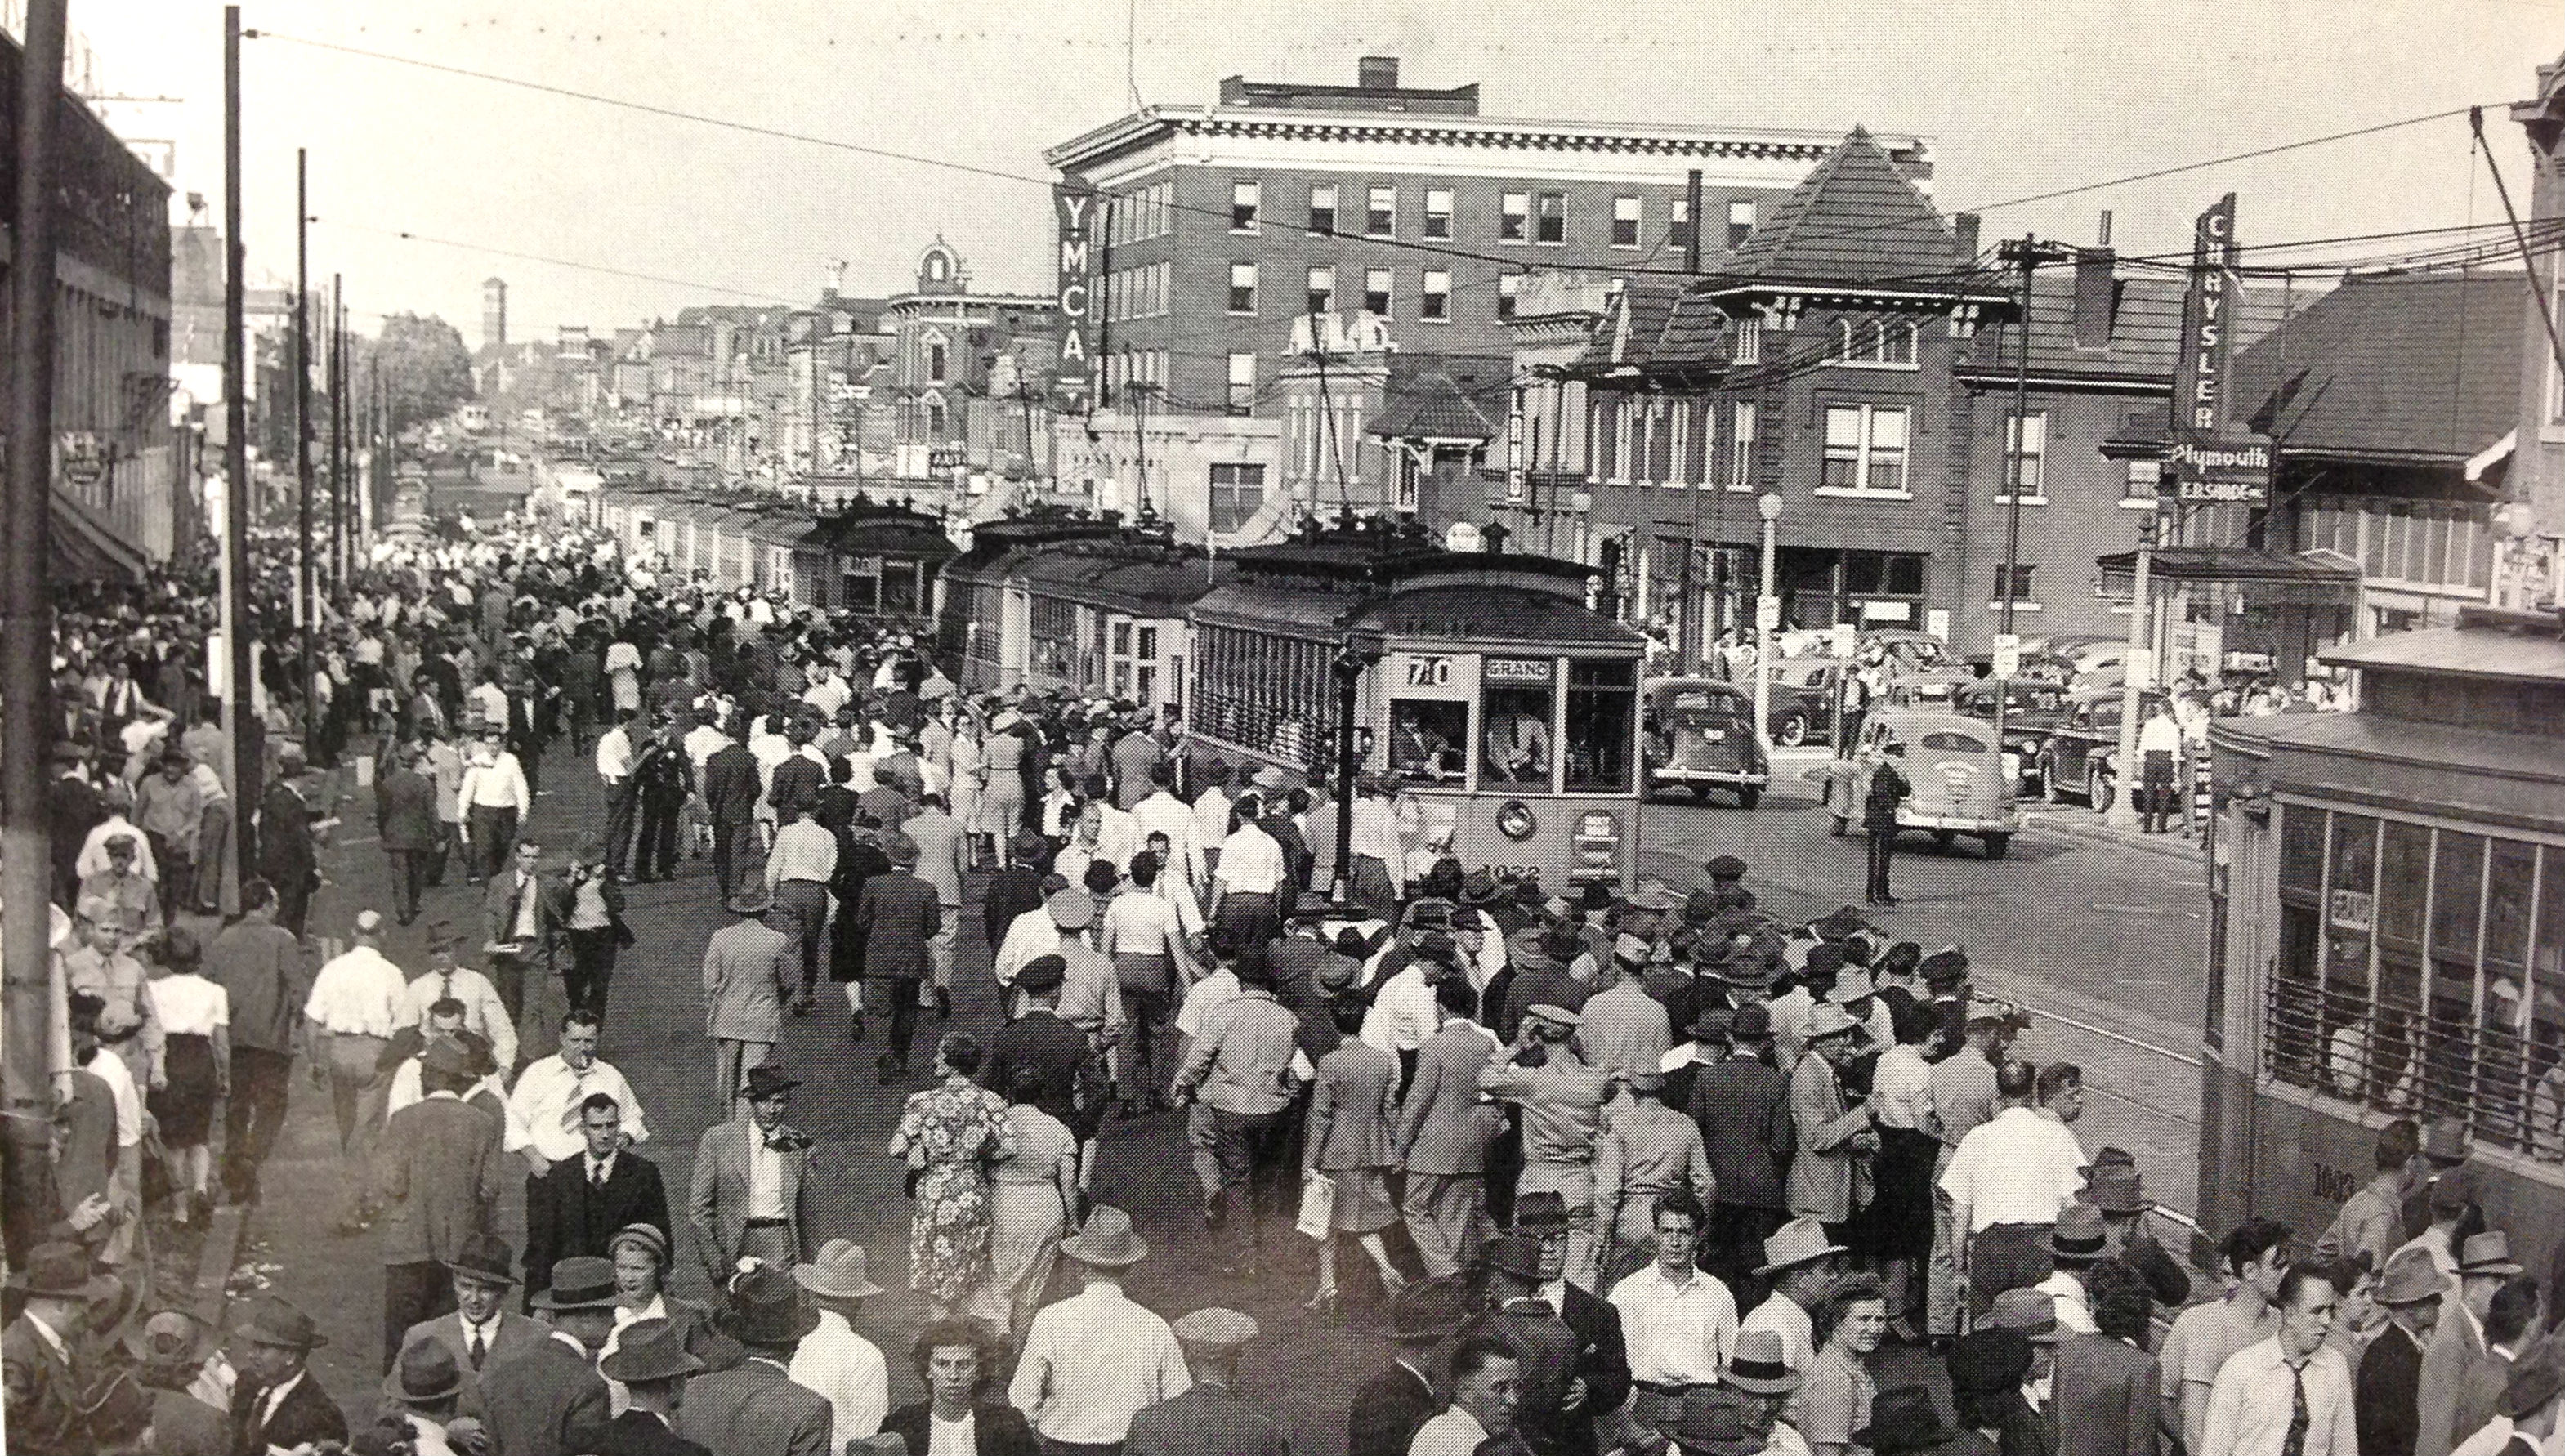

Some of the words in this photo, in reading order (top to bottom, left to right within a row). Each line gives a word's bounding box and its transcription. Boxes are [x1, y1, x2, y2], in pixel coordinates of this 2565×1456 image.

[2195, 214, 2226, 428] CHRYSLER
[2170, 444, 2270, 475] Plymouth
[1408, 655, 1452, 686] 70
[1487, 659, 1548, 678] GRAND
